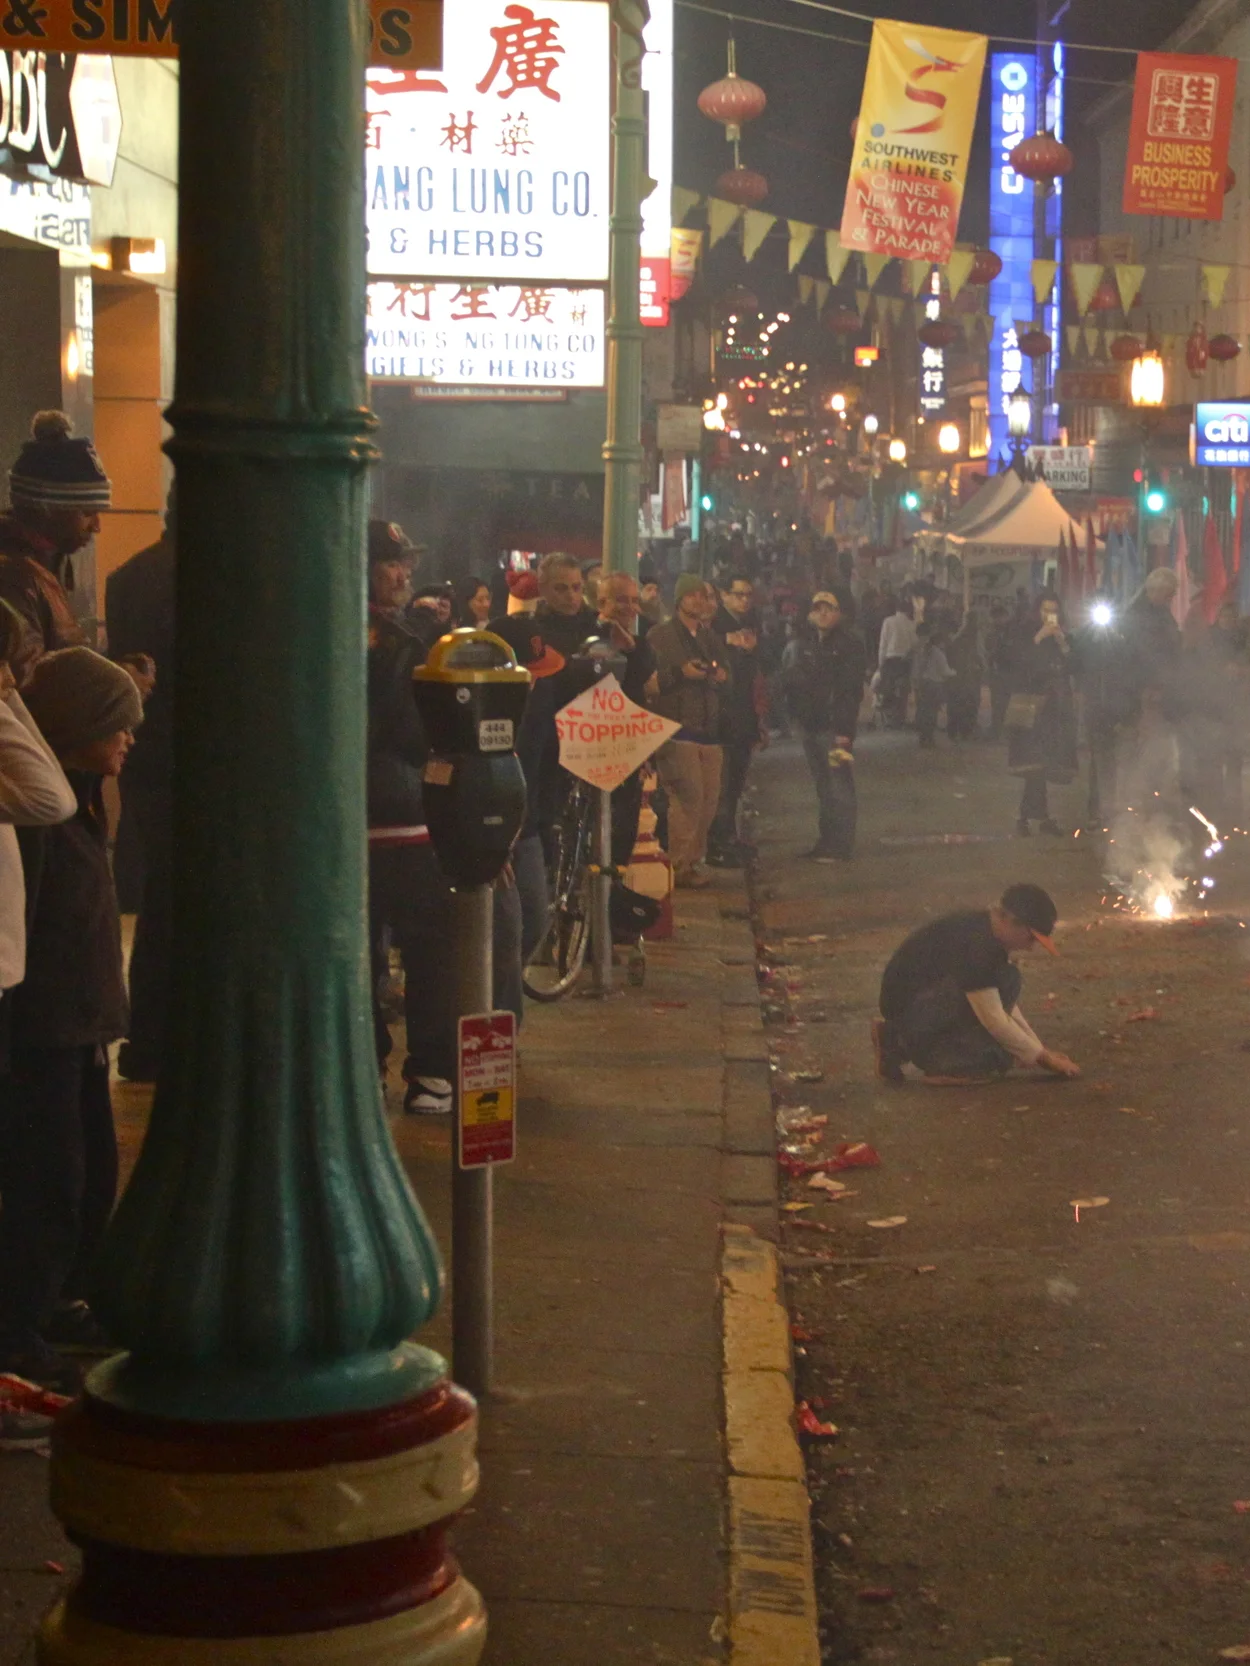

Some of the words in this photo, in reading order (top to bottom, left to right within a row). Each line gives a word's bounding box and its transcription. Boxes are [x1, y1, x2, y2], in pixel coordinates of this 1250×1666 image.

[864, 140, 959, 167] SOUTHWEST
[1143, 140, 1212, 168] BUSINESS
[861, 157, 953, 183] AIRLINES
[1131, 164, 1220, 192] PROSPERITY
[452, 168, 534, 215] LUNG
[551, 170, 598, 218] CO.
[871, 173, 940, 200] CHINESE
[856, 188, 898, 210] NEW
[905, 196, 950, 220] YEAR
[861, 208, 937, 237] FESTIVAL
[389, 227, 409, 254] &
[428, 229, 544, 258] HERBS
[874, 228, 942, 256] PARADE
[488, 358, 576, 380] HERBS
[1204, 414, 1249, 443] citi
[525, 477, 591, 500] TEA
[1045, 470, 1087, 483] ARKING
[592, 688, 625, 712] NO
[556, 718, 665, 743] STOPPING
